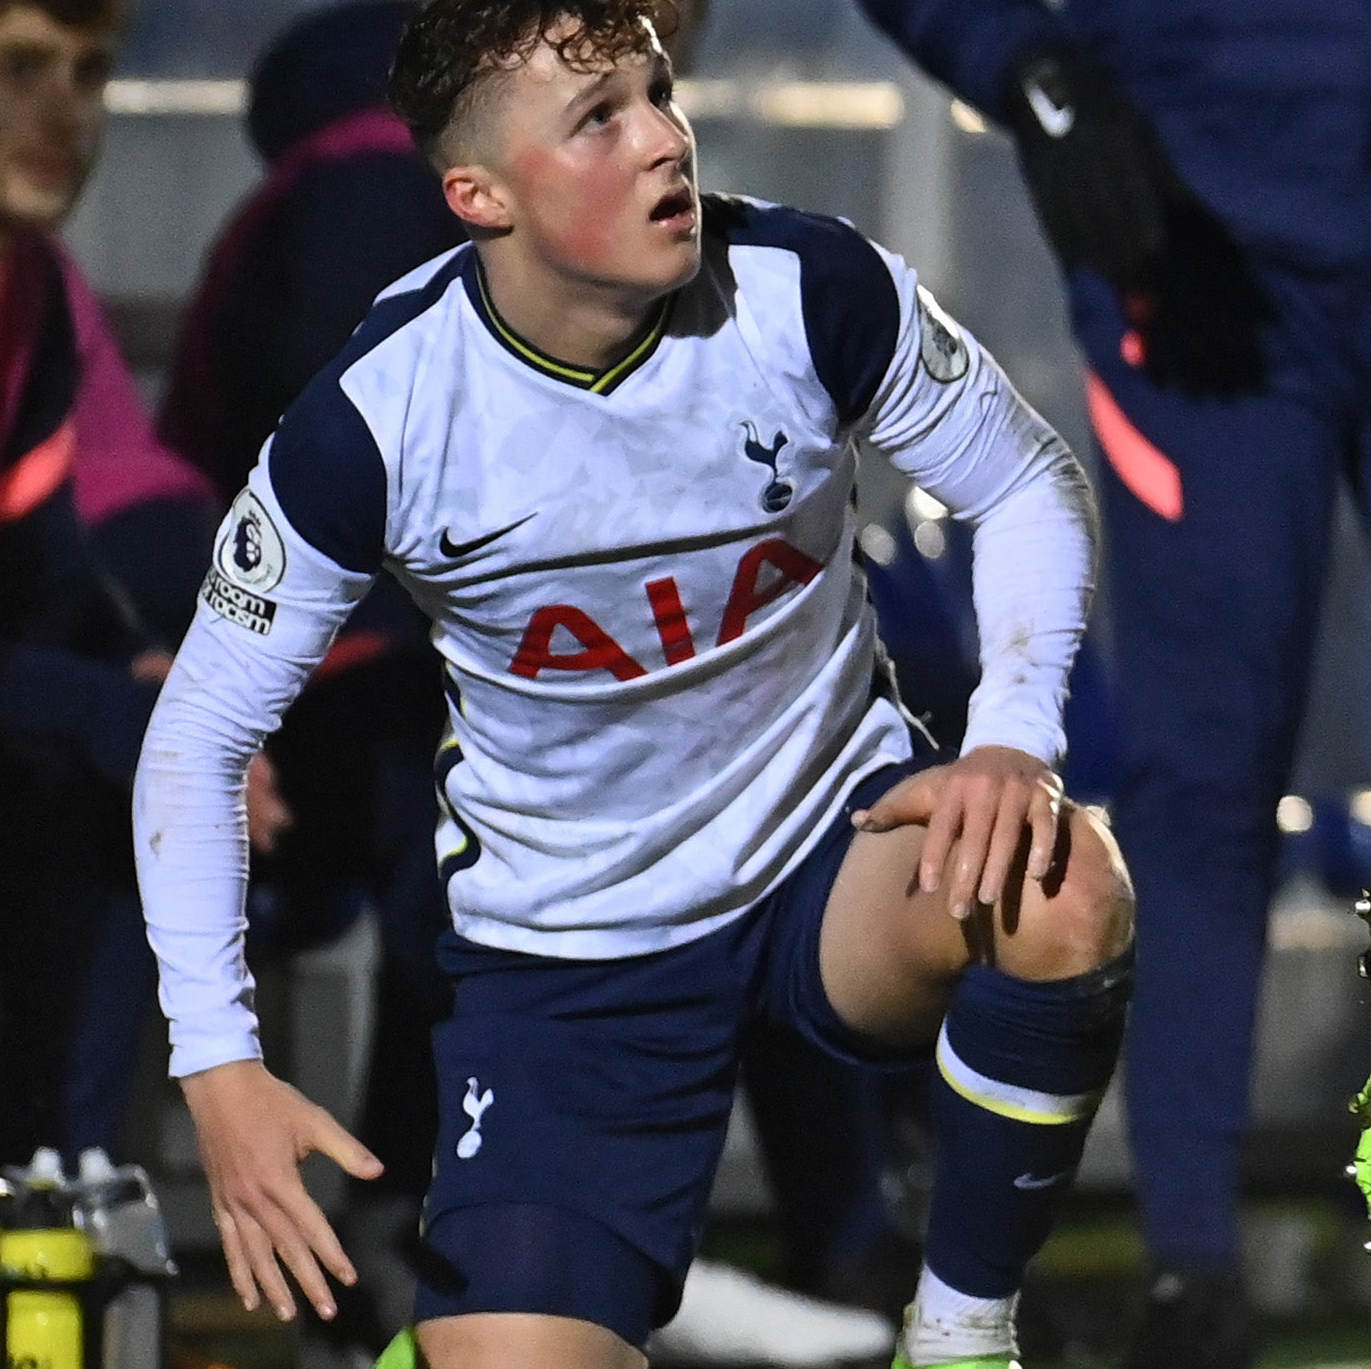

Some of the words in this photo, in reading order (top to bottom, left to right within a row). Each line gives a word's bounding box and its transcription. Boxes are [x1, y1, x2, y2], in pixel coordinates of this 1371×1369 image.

[208, 592, 271, 636] racism
[213, 576, 266, 617] room
[508, 539, 825, 681] AIA
